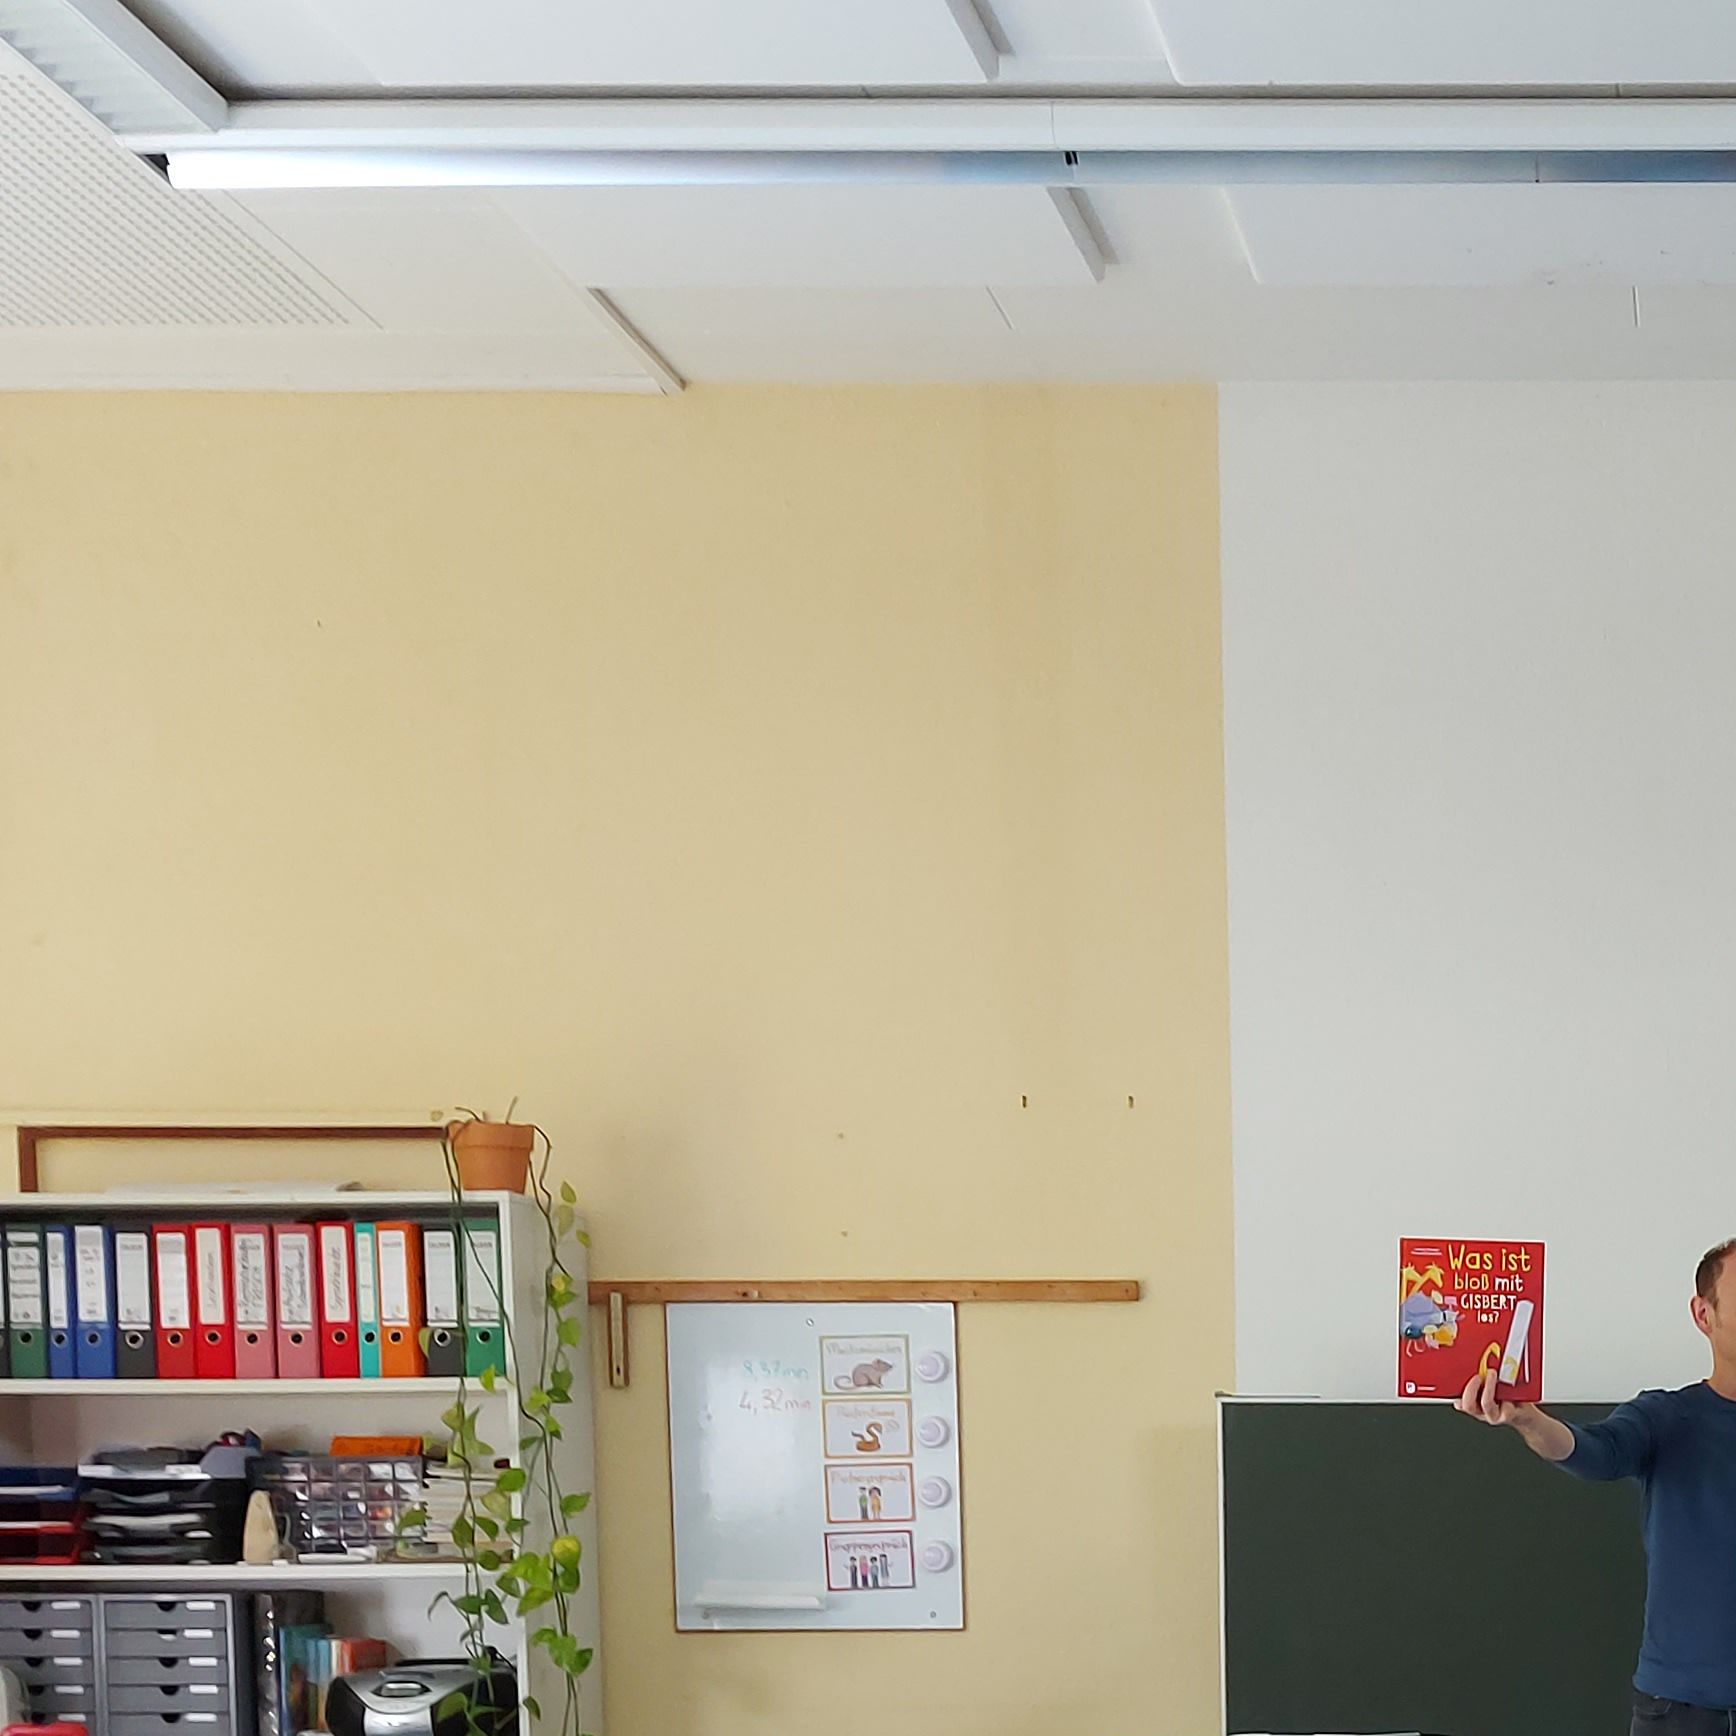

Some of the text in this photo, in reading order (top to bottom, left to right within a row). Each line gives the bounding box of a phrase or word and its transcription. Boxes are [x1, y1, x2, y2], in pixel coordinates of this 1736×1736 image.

[1448, 1244, 1531, 1272] Was ist
[1454, 1273, 1524, 1291] bloß mit
[1461, 1293, 1517, 1310] GISBERT
[1477, 1311, 1500, 1323] los?
